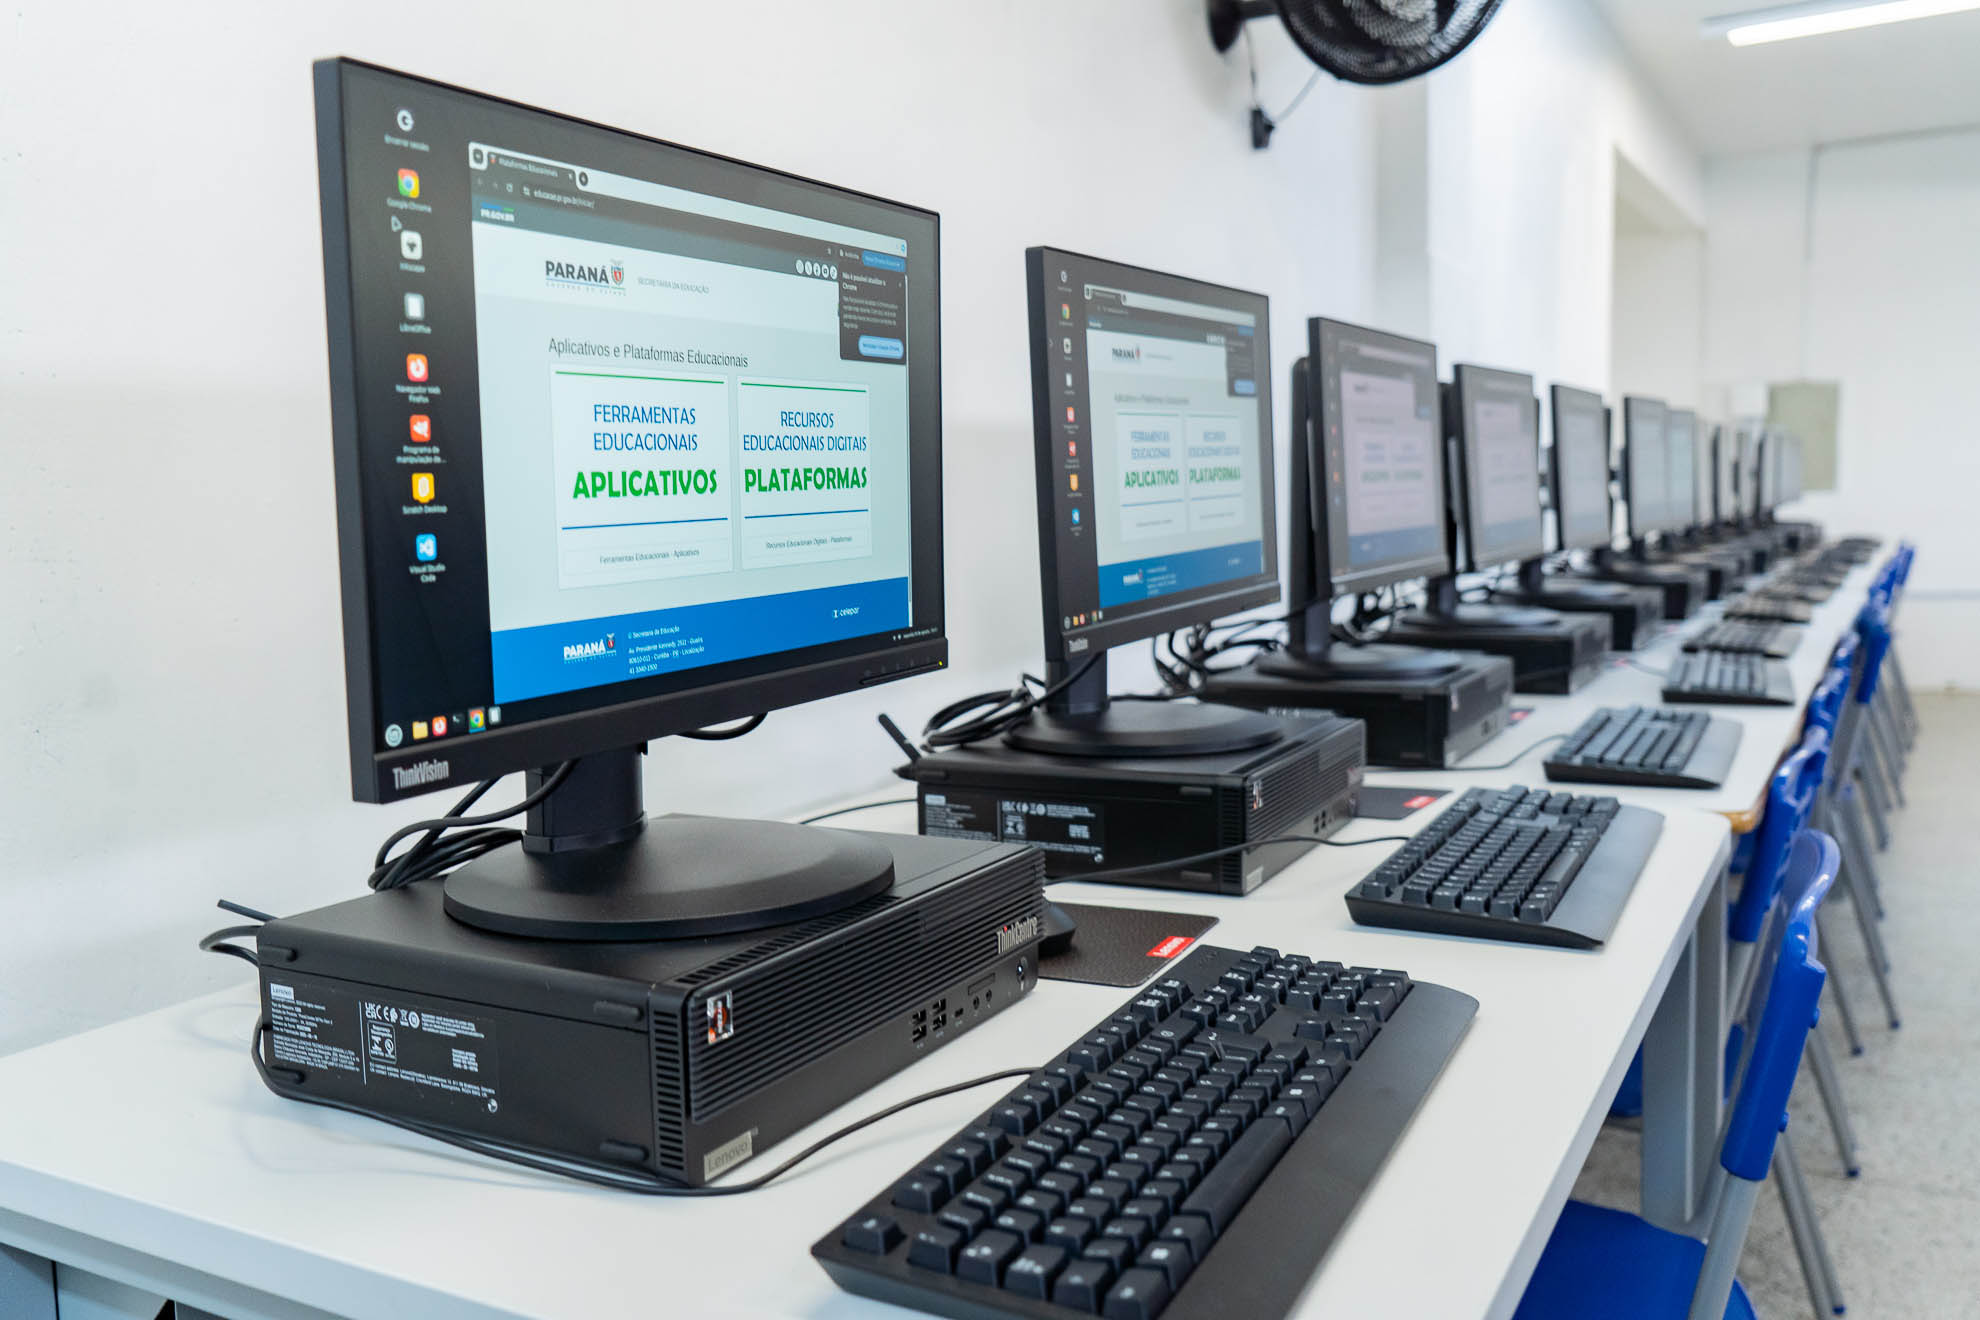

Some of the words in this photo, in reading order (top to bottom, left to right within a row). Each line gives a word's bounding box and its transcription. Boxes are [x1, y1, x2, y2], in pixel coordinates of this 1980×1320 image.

[545, 260, 609, 284] PARANÁ
[549, 337, 610, 358] Aplicativos
[613, 346, 620, 358] e
[624, 344, 684, 363] Plataformas
[687, 349, 749, 368] Educacionais
[593, 404, 696, 425] FERRAMENTAS
[780, 410, 834, 429] RECURSOS
[593, 432, 698, 451] EDUCACIONAIS
[743, 434, 825, 451] EDUCACIONAIS
[826, 435, 867, 451] DIGITAIS
[573, 469, 717, 499] APLICATIVOS
[744, 466, 868, 493] PLATAFORMAS
[563, 639, 606, 659] PARANÁ
[392, 759, 449, 790] ThinkVision
[707, 1142, 749, 1168] Lenovo
